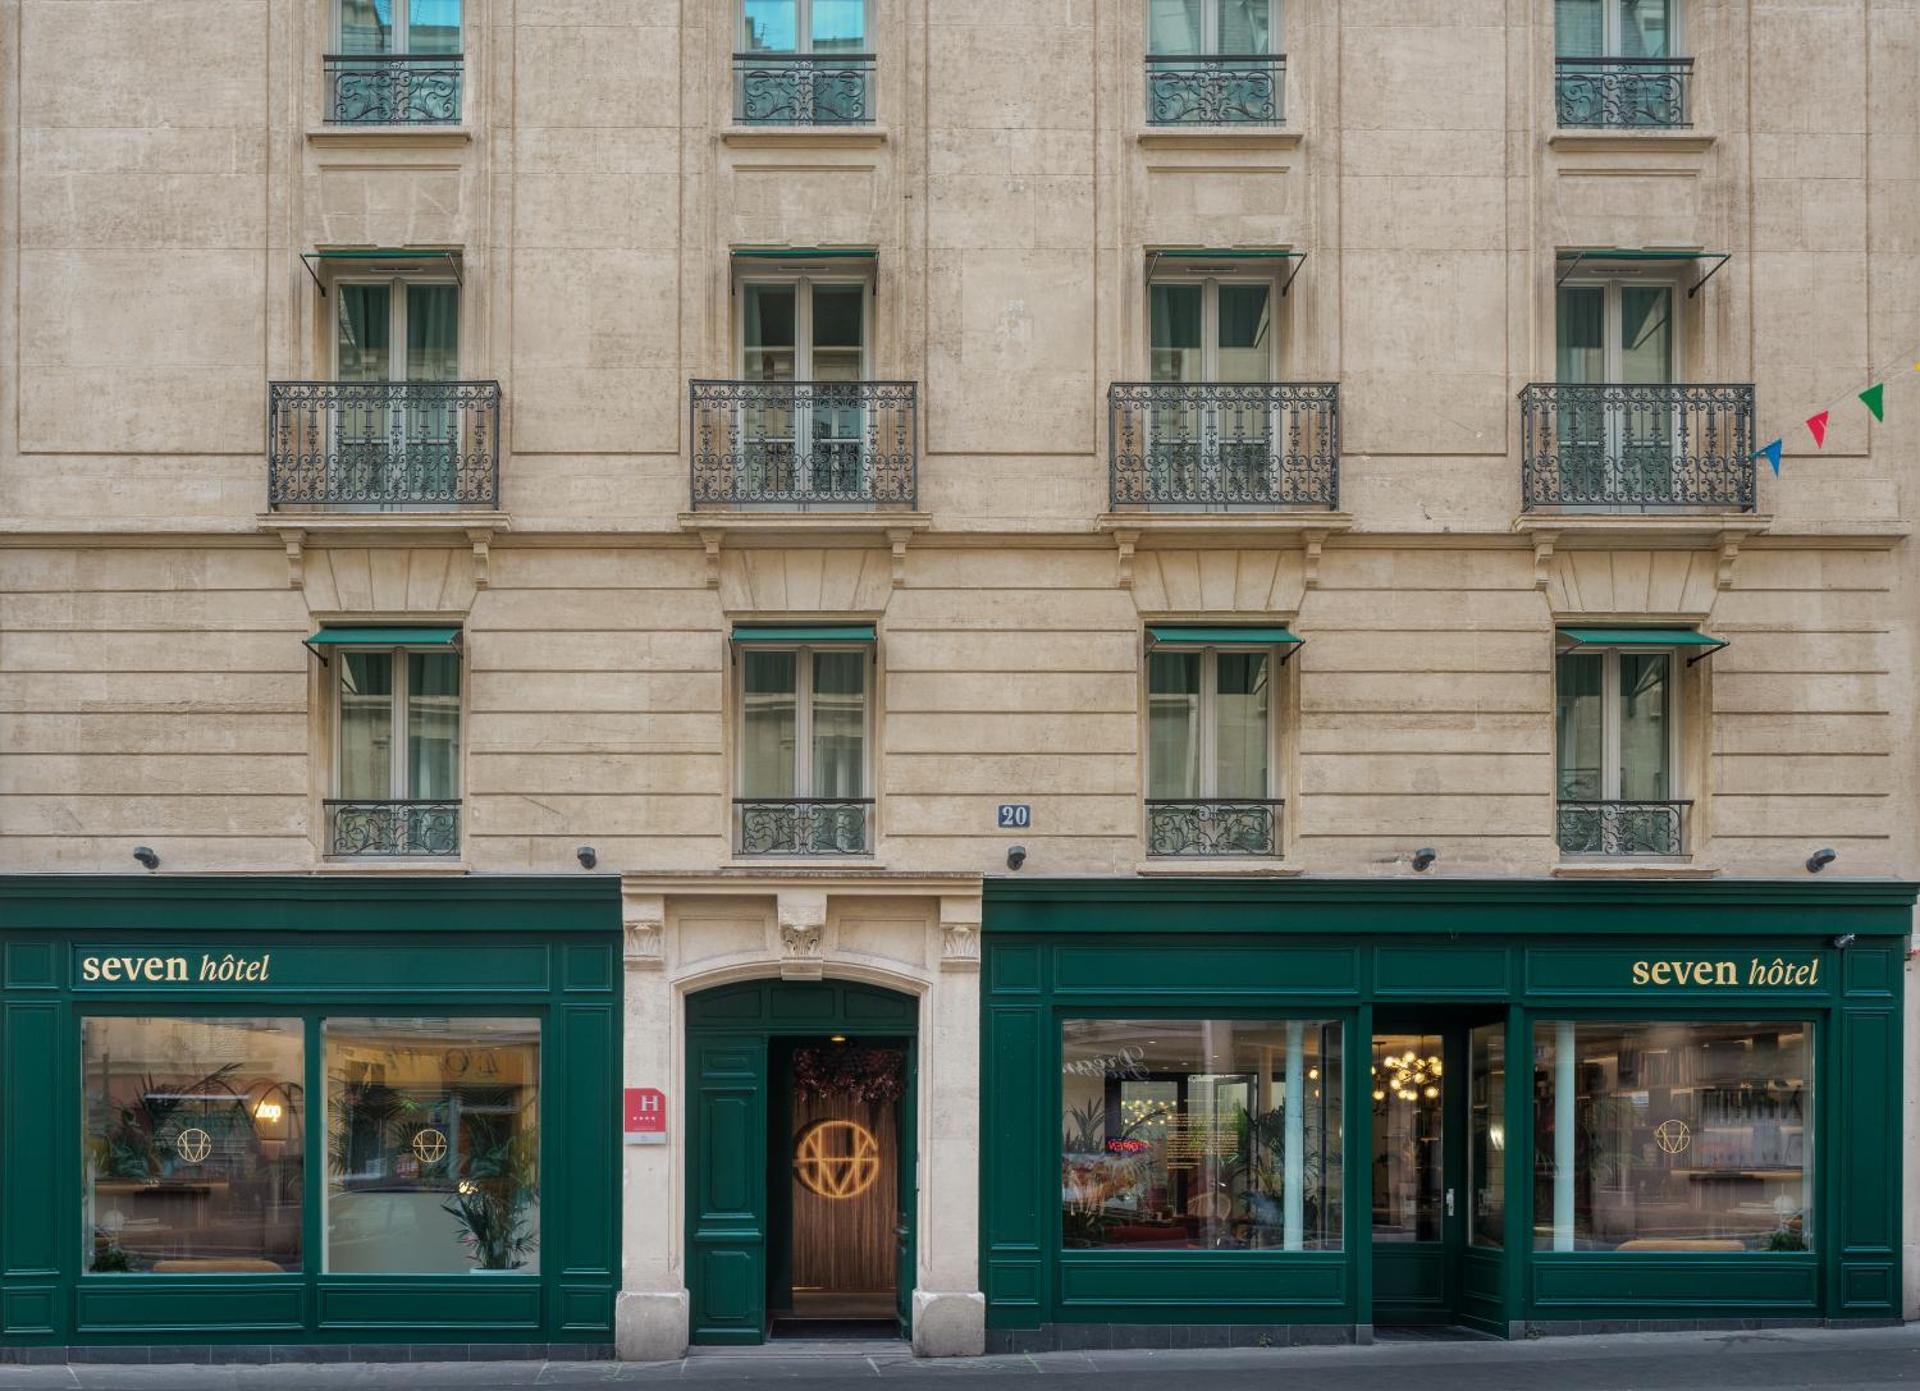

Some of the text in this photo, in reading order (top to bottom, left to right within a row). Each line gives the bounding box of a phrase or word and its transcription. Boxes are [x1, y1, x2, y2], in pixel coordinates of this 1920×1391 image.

[1001, 806, 1028, 825] 20
[83, 954, 271, 982] seven hôtel
[1632, 957, 1819, 985] seven hôtel
[641, 1095, 659, 1111] H
